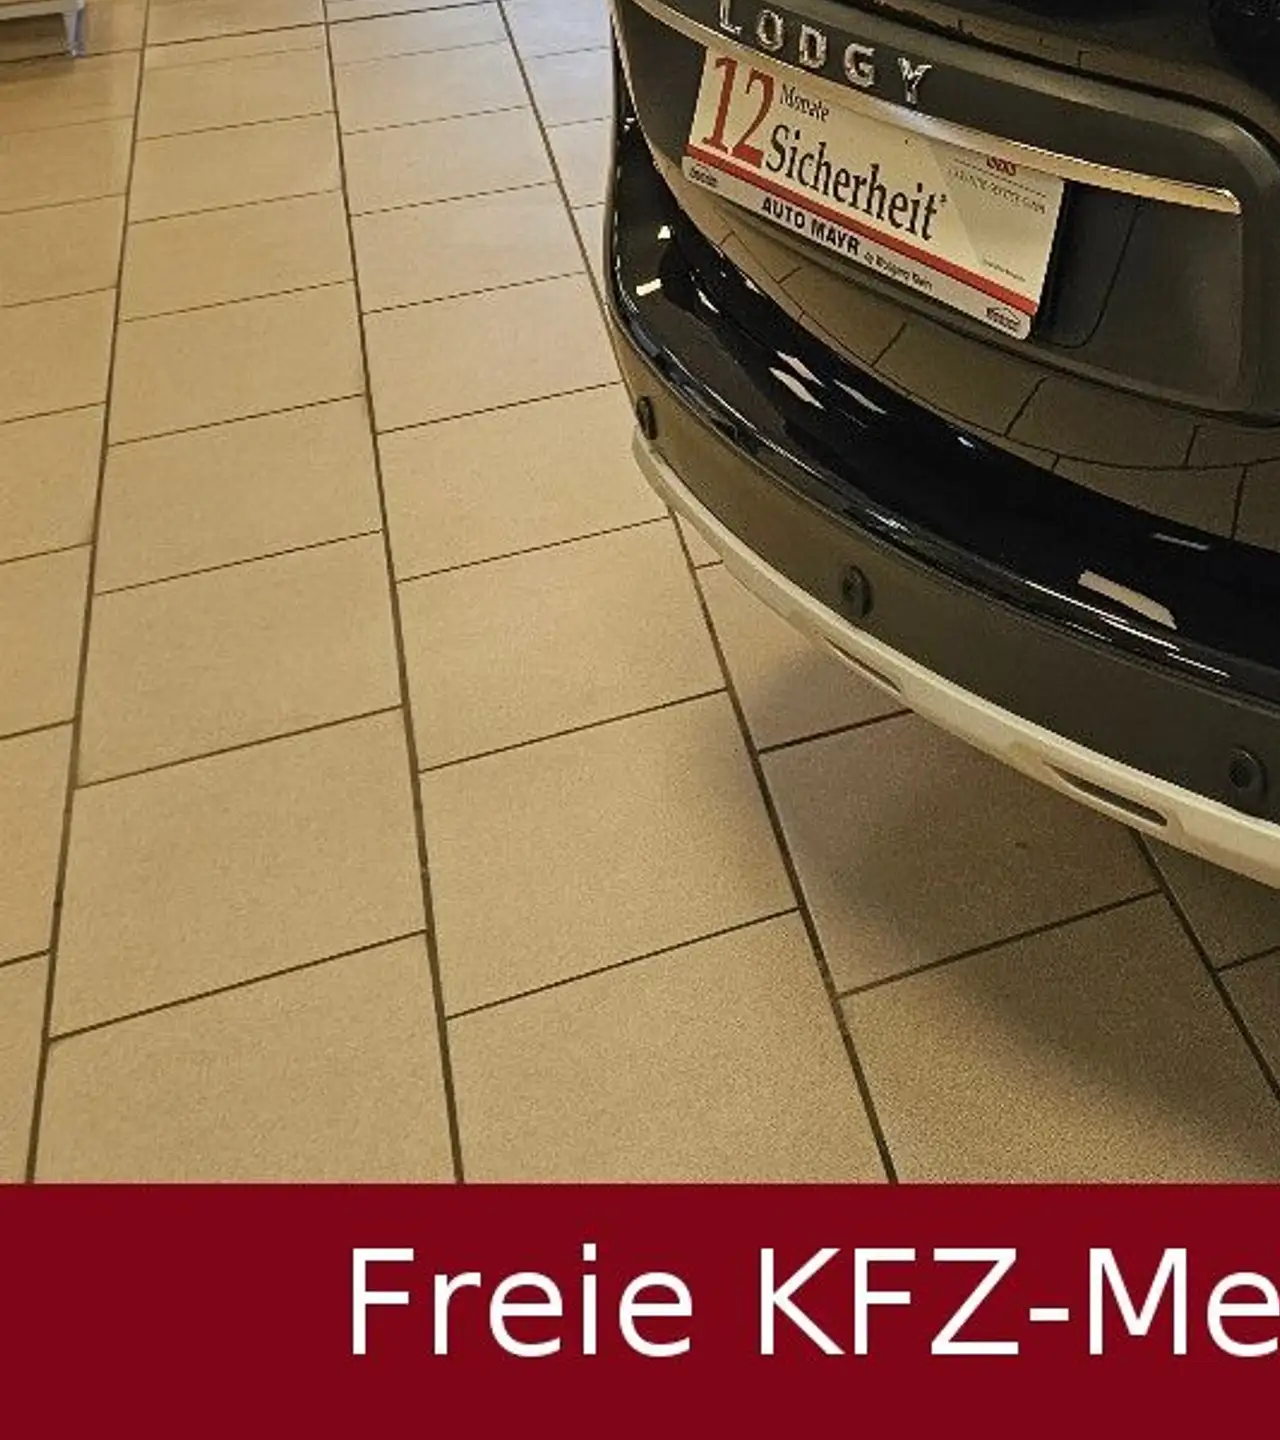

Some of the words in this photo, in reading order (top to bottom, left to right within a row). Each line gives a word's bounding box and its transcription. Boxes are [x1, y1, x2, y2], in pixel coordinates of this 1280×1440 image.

[702, 55, 775, 169] 12
[779, 83, 830, 124] Monate
[760, 195, 806, 229] AUTO
[810, 219, 861, 257] MAYR
